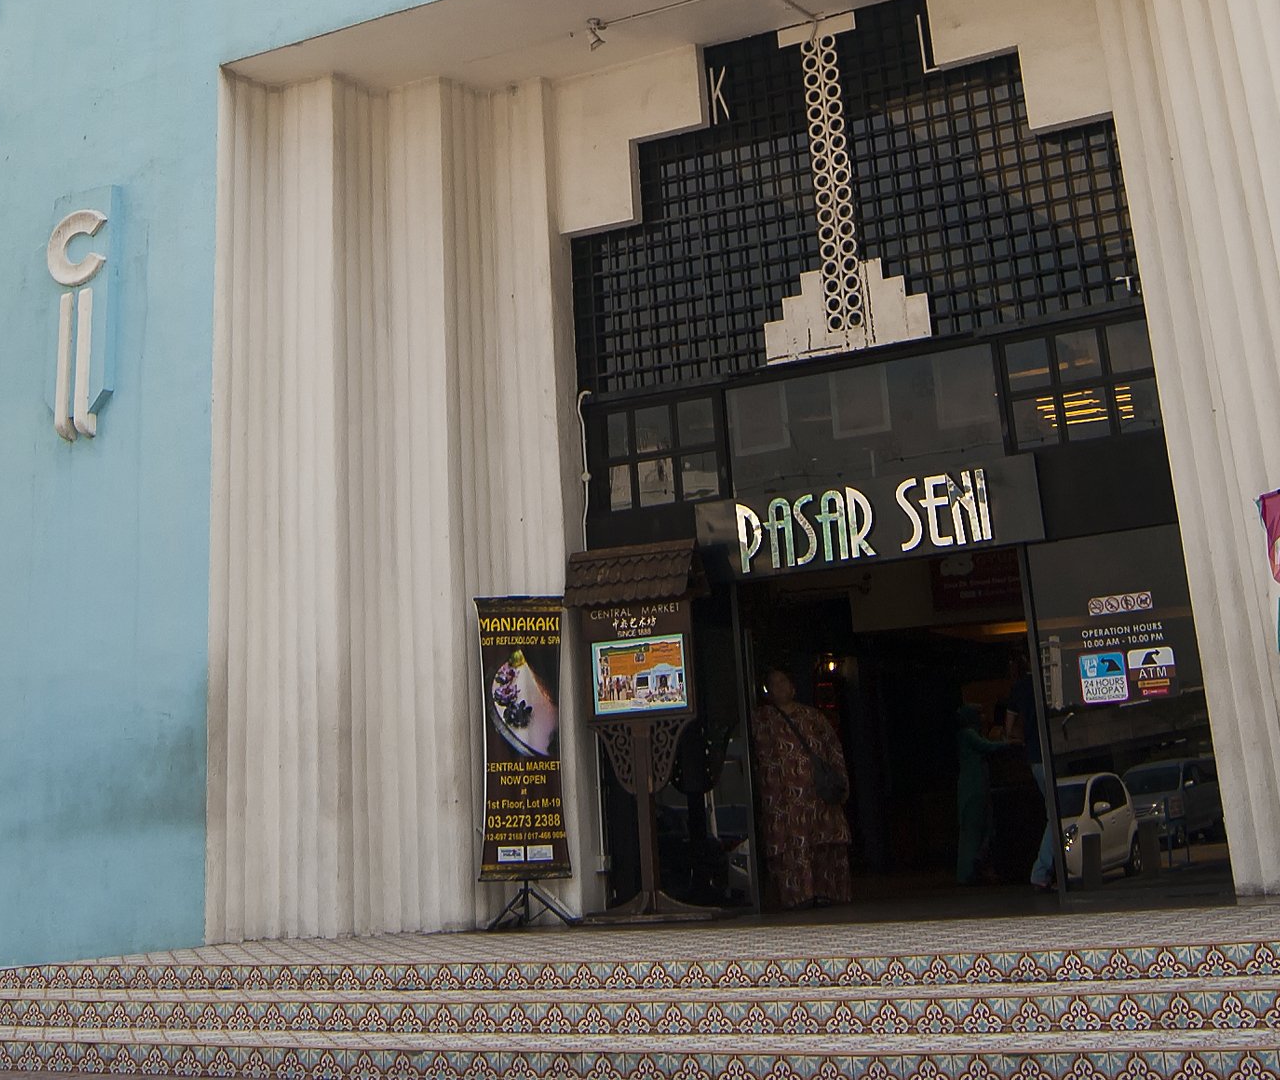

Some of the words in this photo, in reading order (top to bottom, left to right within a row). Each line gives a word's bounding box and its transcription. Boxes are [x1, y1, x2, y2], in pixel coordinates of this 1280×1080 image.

[734, 485, 877, 574] PASAR
[895, 468, 993, 552] SENI
[590, 607, 632, 620] CENTRAL
[641, 602, 680, 615] MARKET
[480, 616, 560, 632] MANJAKAKI
[617, 630, 637, 638] SINCE
[1081, 625, 1131, 639] OPERATION
[1133, 622, 1163, 633] HOURS
[481, 637, 494, 646] OOT
[496, 635, 538, 646] REFLEXOLOGY
[540, 636, 546, 645] &
[547, 635, 561, 645] SPA
[1083, 639, 1104, 648] 10.00
[1106, 638, 1120, 647] AM
[1128, 634, 1149, 644] 10.00
[1150, 633, 1164, 641] PM
[1138, 666, 1168, 679] ATM
[1084, 680, 1094, 689] 24
[1096, 677, 1125, 688] HOURS
[1085, 686, 1125, 697] AUTOPAY
[526, 760, 560, 771] MARKET
[500, 776, 521, 785] NOW
[522, 775, 546, 784] OPEN
[488, 800, 499, 809] 1st
[501, 800, 525, 809] Floor,
[527, 799, 540, 808] Lot
[488, 814, 532, 829] 03-2273
[534, 814, 560, 827] 2388
